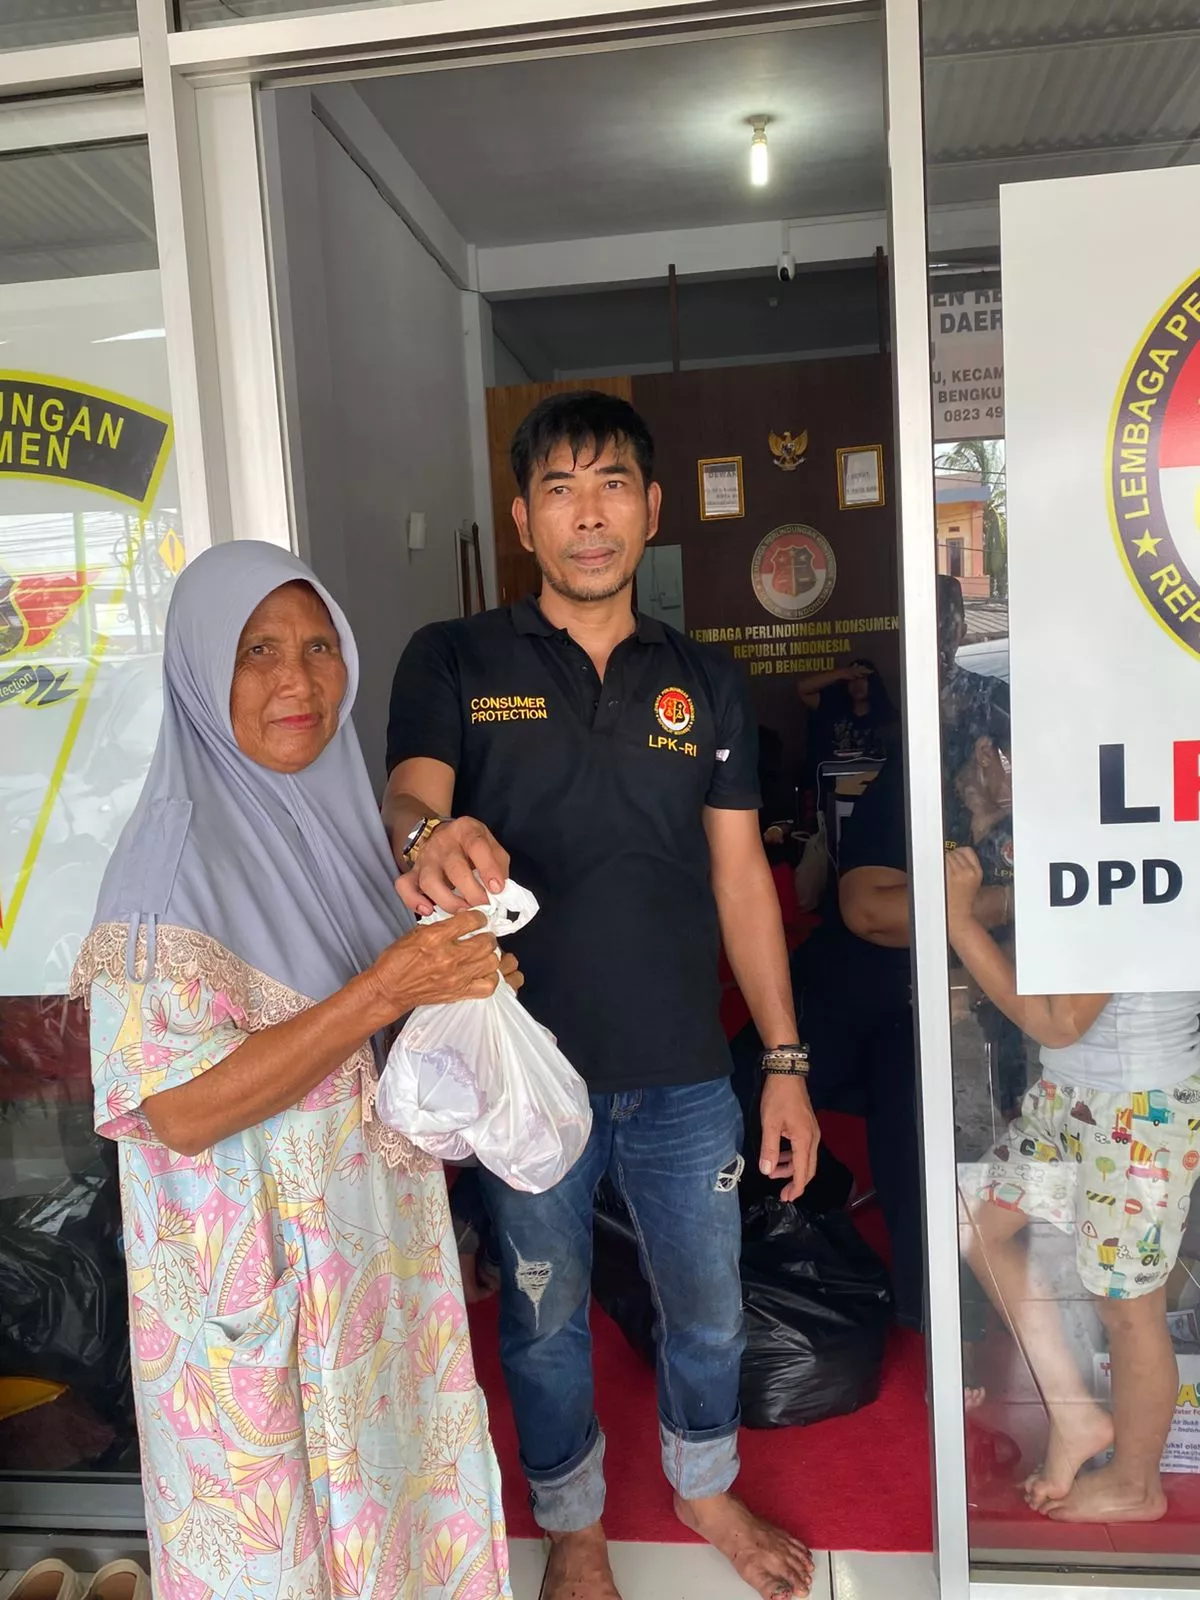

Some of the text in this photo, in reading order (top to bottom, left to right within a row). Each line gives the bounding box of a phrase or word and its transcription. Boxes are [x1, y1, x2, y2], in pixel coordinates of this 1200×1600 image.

[938, 386, 1002, 403] BENGKU
[0, 391, 124, 450] NGAN
[944, 408, 980, 422] 0823
[1119, 349, 1179, 520] LEMBAGA
[1149, 563, 1200, 623] REP
[690, 616, 899, 643] LEMBAGA PERLINDUNGAN KONSUMEN
[734, 639, 851, 659] REPUBLIK INDONESIA
[750, 657, 834, 676] DPD BENGKULU
[471, 695, 546, 711] CONSUMER
[471, 708, 548, 724] PROTECTION
[648, 734, 697, 757] LPK-RI
[1049, 858, 1184, 907] DPD
[1175, 1383, 1200, 1408] A
